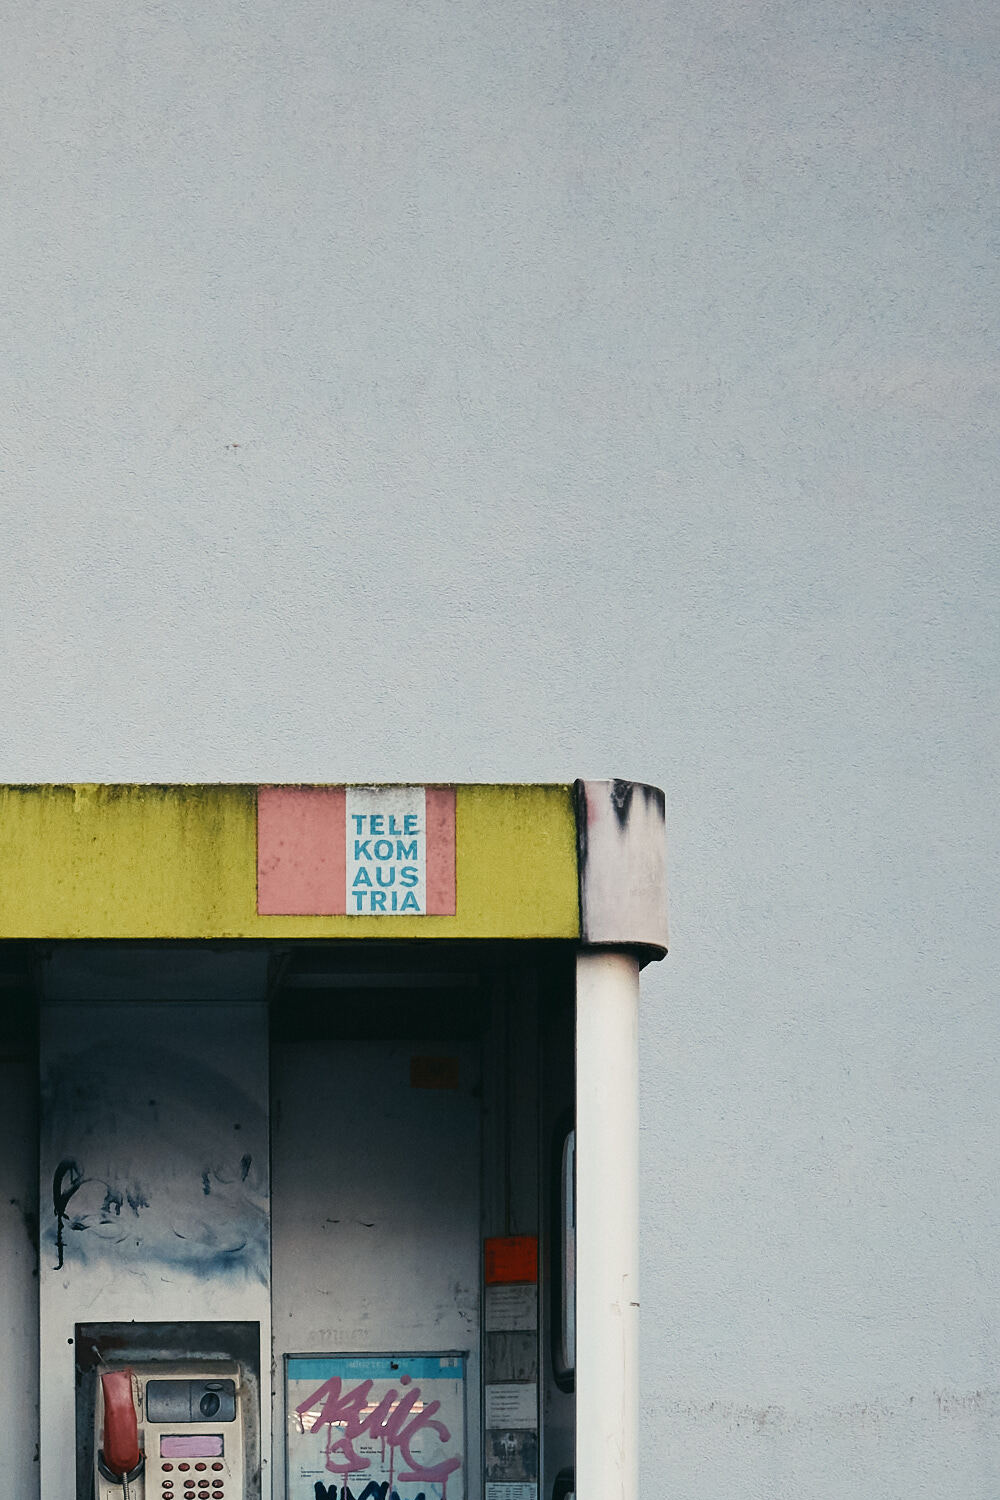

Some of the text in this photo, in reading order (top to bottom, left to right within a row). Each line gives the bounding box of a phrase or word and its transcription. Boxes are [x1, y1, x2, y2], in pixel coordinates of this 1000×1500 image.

[351, 814, 419, 836] TELE
[353, 839, 418, 861] KOM
[352, 866, 419, 888] AUS
[351, 890, 421, 912] TRIA
